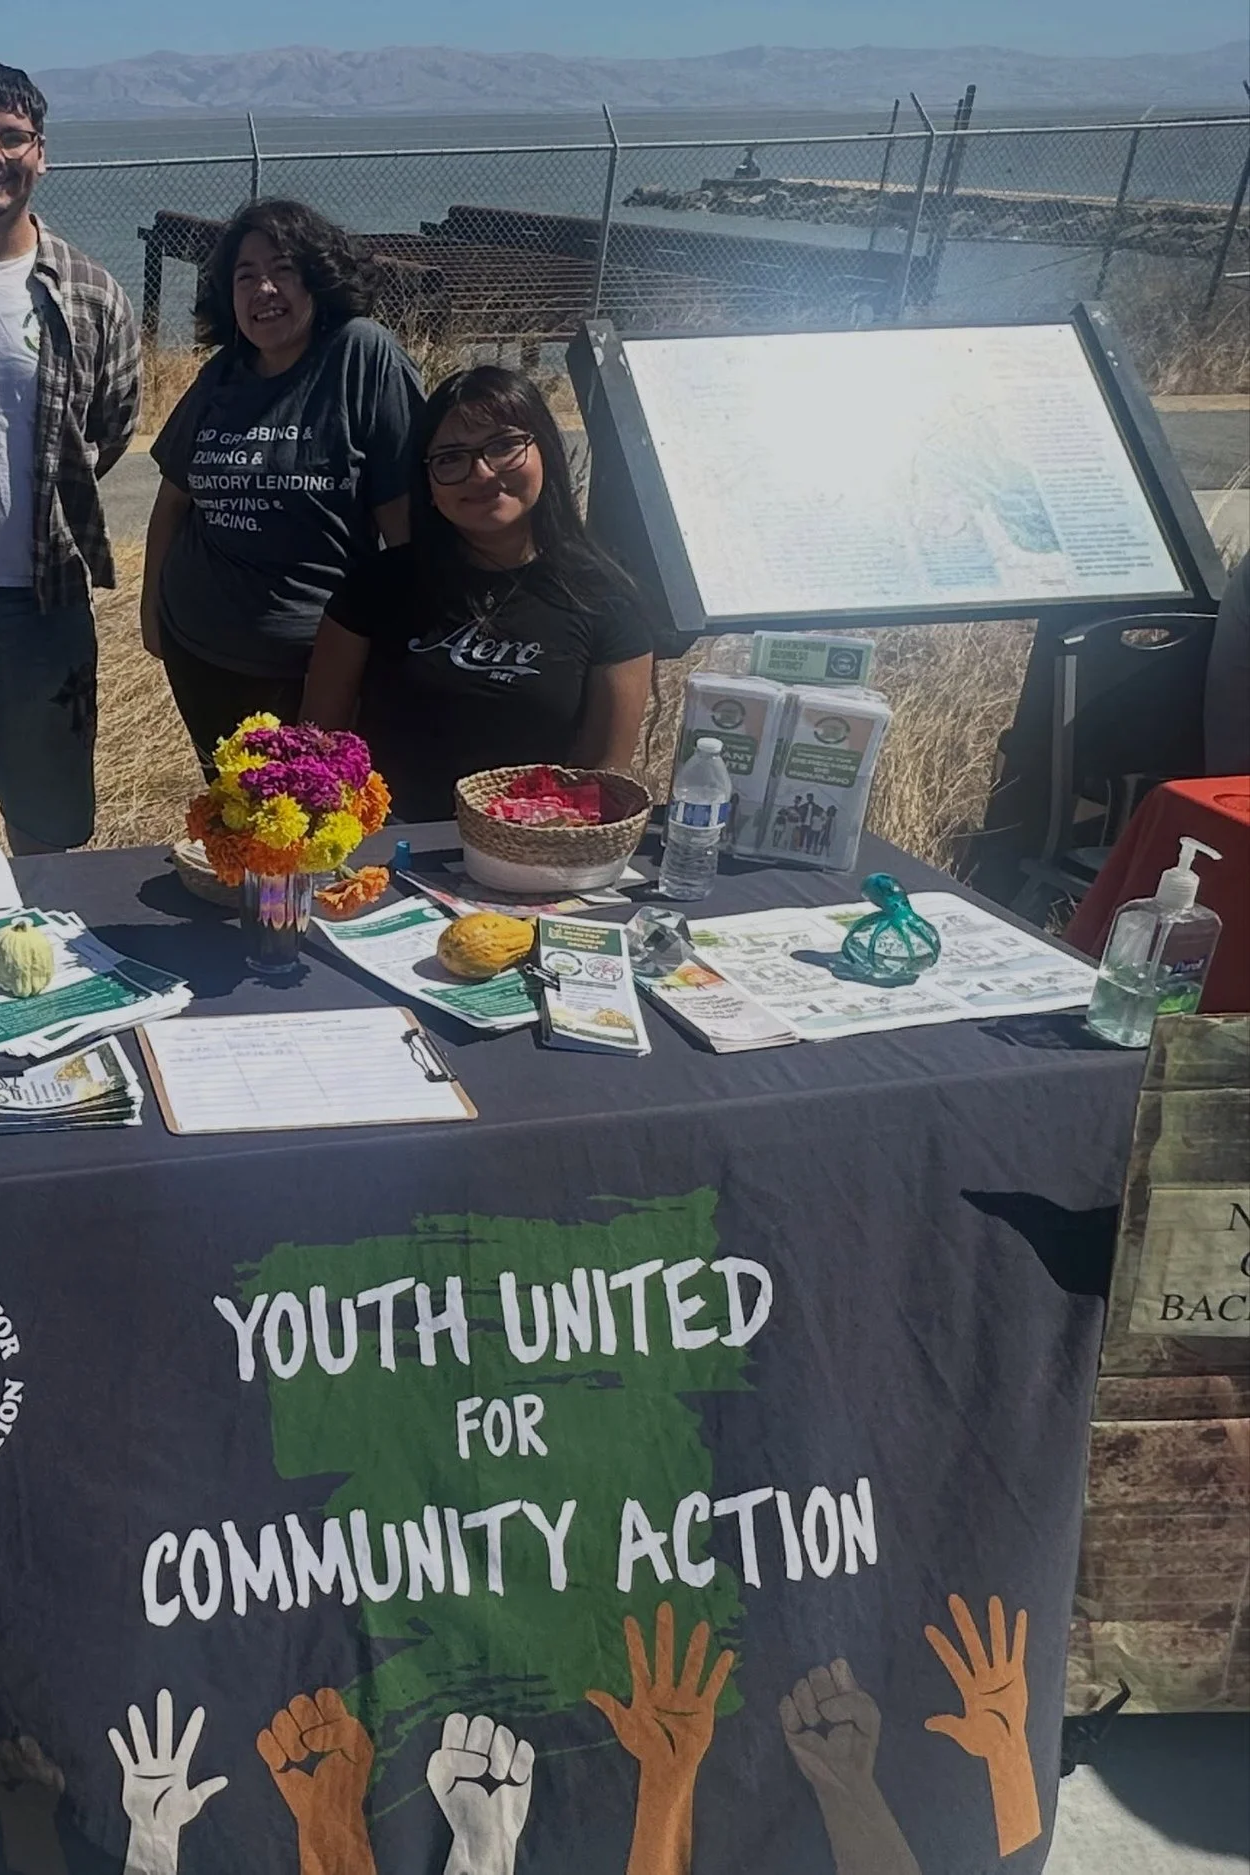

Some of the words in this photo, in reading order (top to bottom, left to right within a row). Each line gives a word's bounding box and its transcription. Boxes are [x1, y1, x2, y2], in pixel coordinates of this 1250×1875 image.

[219, 425, 299, 445] GRBBING
[251, 451, 264, 465] &
[256, 475, 335, 491] LENDING
[408, 618, 545, 674] Aero
[213, 1275, 470, 1382] YOUTH
[498, 1256, 774, 1364] UNITED
[1158, 1294, 1250, 1321] BAC
[456, 1393, 548, 1459] FOR
[141, 1499, 578, 1627] COMMUNITY
[616, 1477, 878, 1594] ACTION
